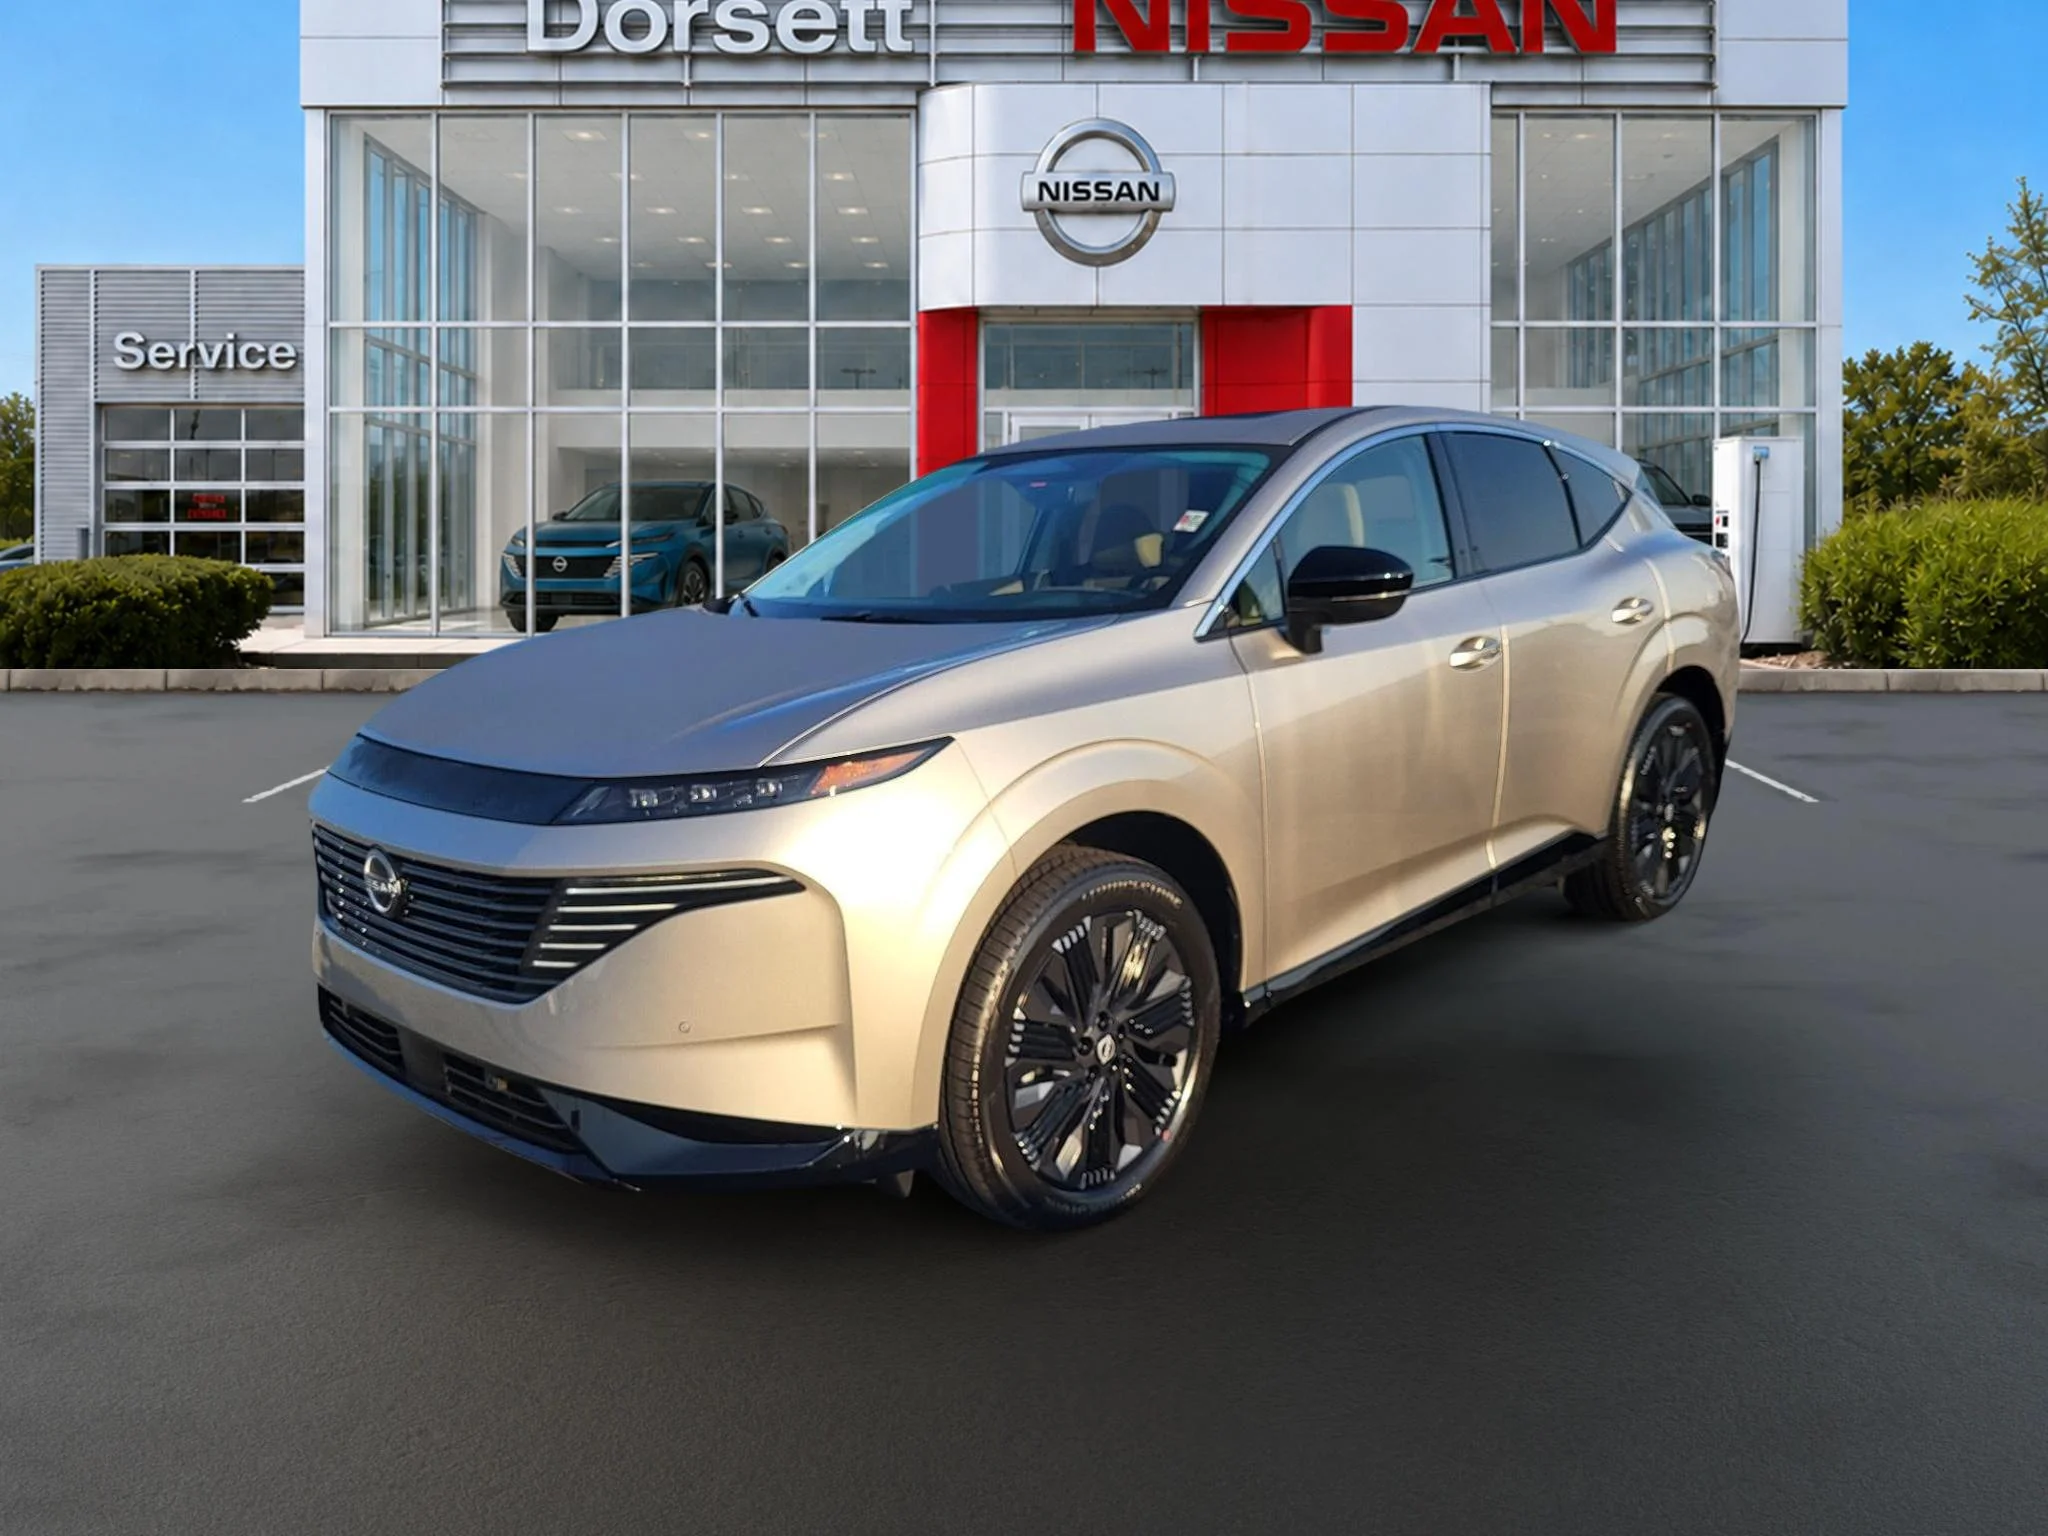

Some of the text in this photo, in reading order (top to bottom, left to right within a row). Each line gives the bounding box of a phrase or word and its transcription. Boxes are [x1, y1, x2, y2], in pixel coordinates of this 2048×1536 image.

[526, 0, 914, 53] Dorsett
[1073, 0, 1617, 53] NISSAN
[1038, 181, 1160, 202] NISSAN
[113, 331, 297, 370] Service
